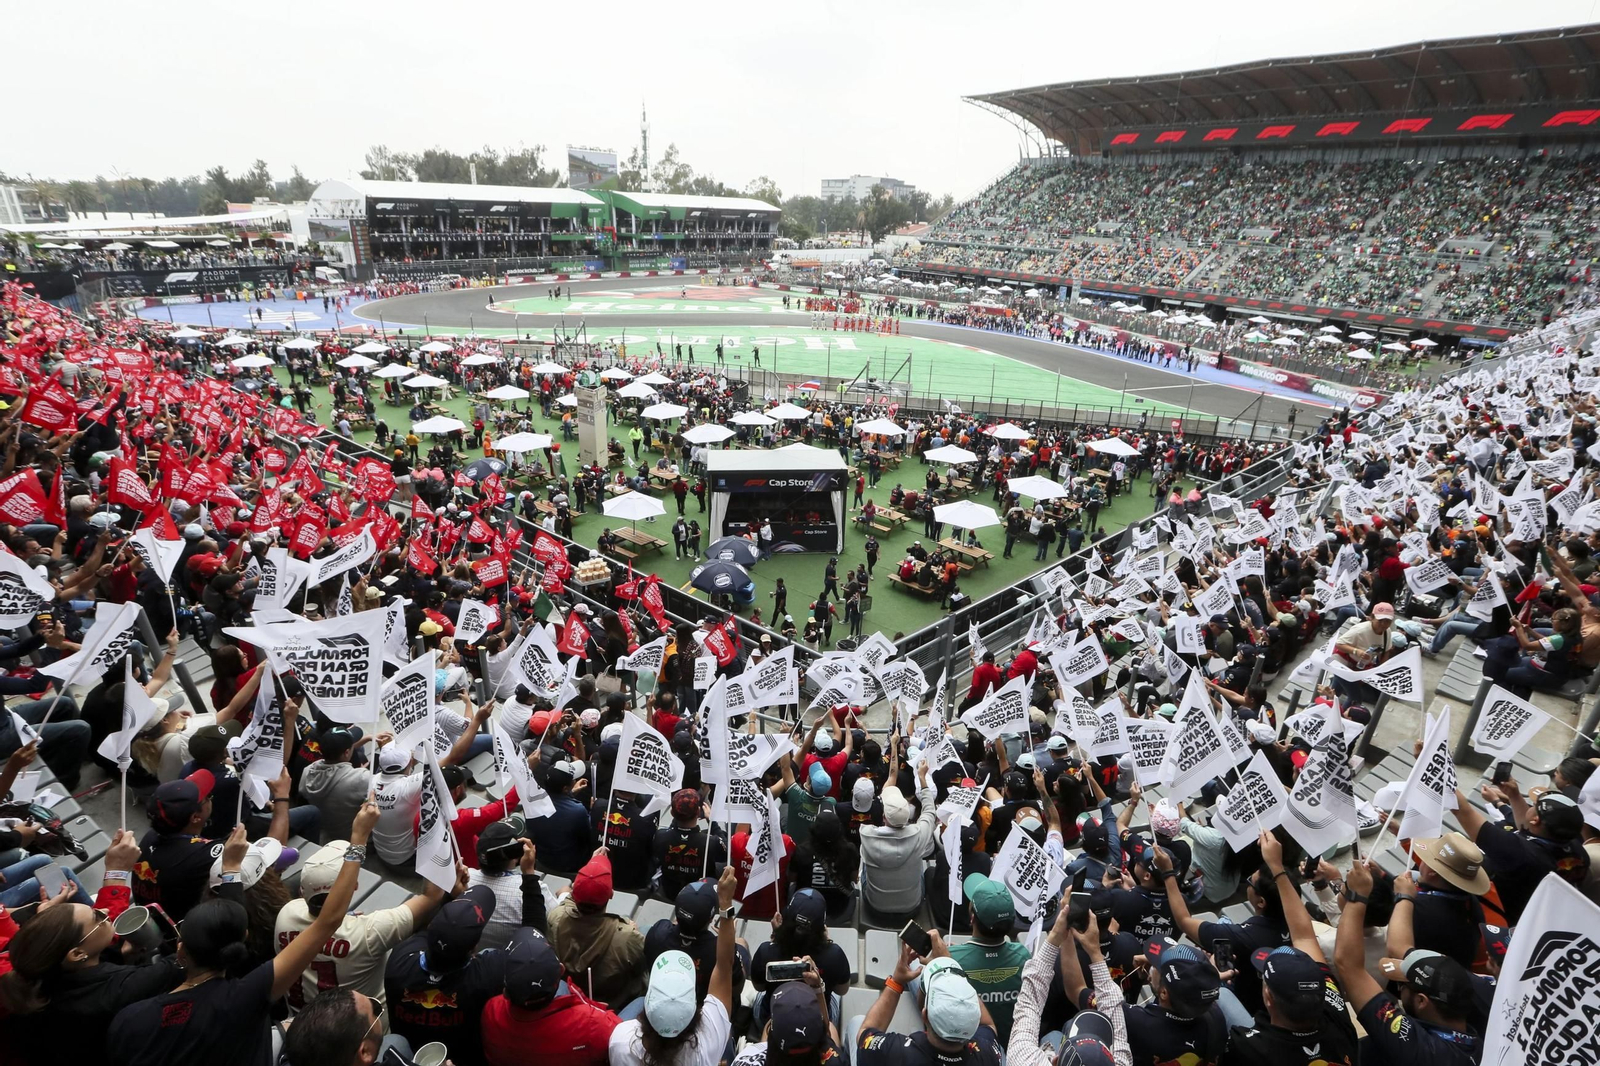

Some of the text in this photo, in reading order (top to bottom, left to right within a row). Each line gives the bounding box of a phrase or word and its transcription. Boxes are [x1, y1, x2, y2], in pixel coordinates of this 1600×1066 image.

[1239, 364, 1288, 383] #MexicoGP
[769, 479, 787, 488] Cap
[262, 727, 283, 736] DE
[258, 739, 283, 749] DE
[1129, 734, 1157, 743] RMULA
[631, 749, 659, 763] GRAN
[632, 740, 670, 761] FORMUL
[1143, 750, 1165, 758] CIUDA
[628, 757, 656, 772] DE LA
[1426, 762, 1440, 778] DE
[627, 766, 640, 776] DE
[1420, 773, 1432, 787] DE
[615, 826, 631, 838] Bull
[598, 835, 619, 845] Mbil
[1135, 925, 1155, 936] Red
[1149, 942, 1161, 955] 11
[396, 1004, 464, 1026] Red Bull
[1400, 1015, 1412, 1041] citrix
[938, 1054, 962, 1062] HONDA
